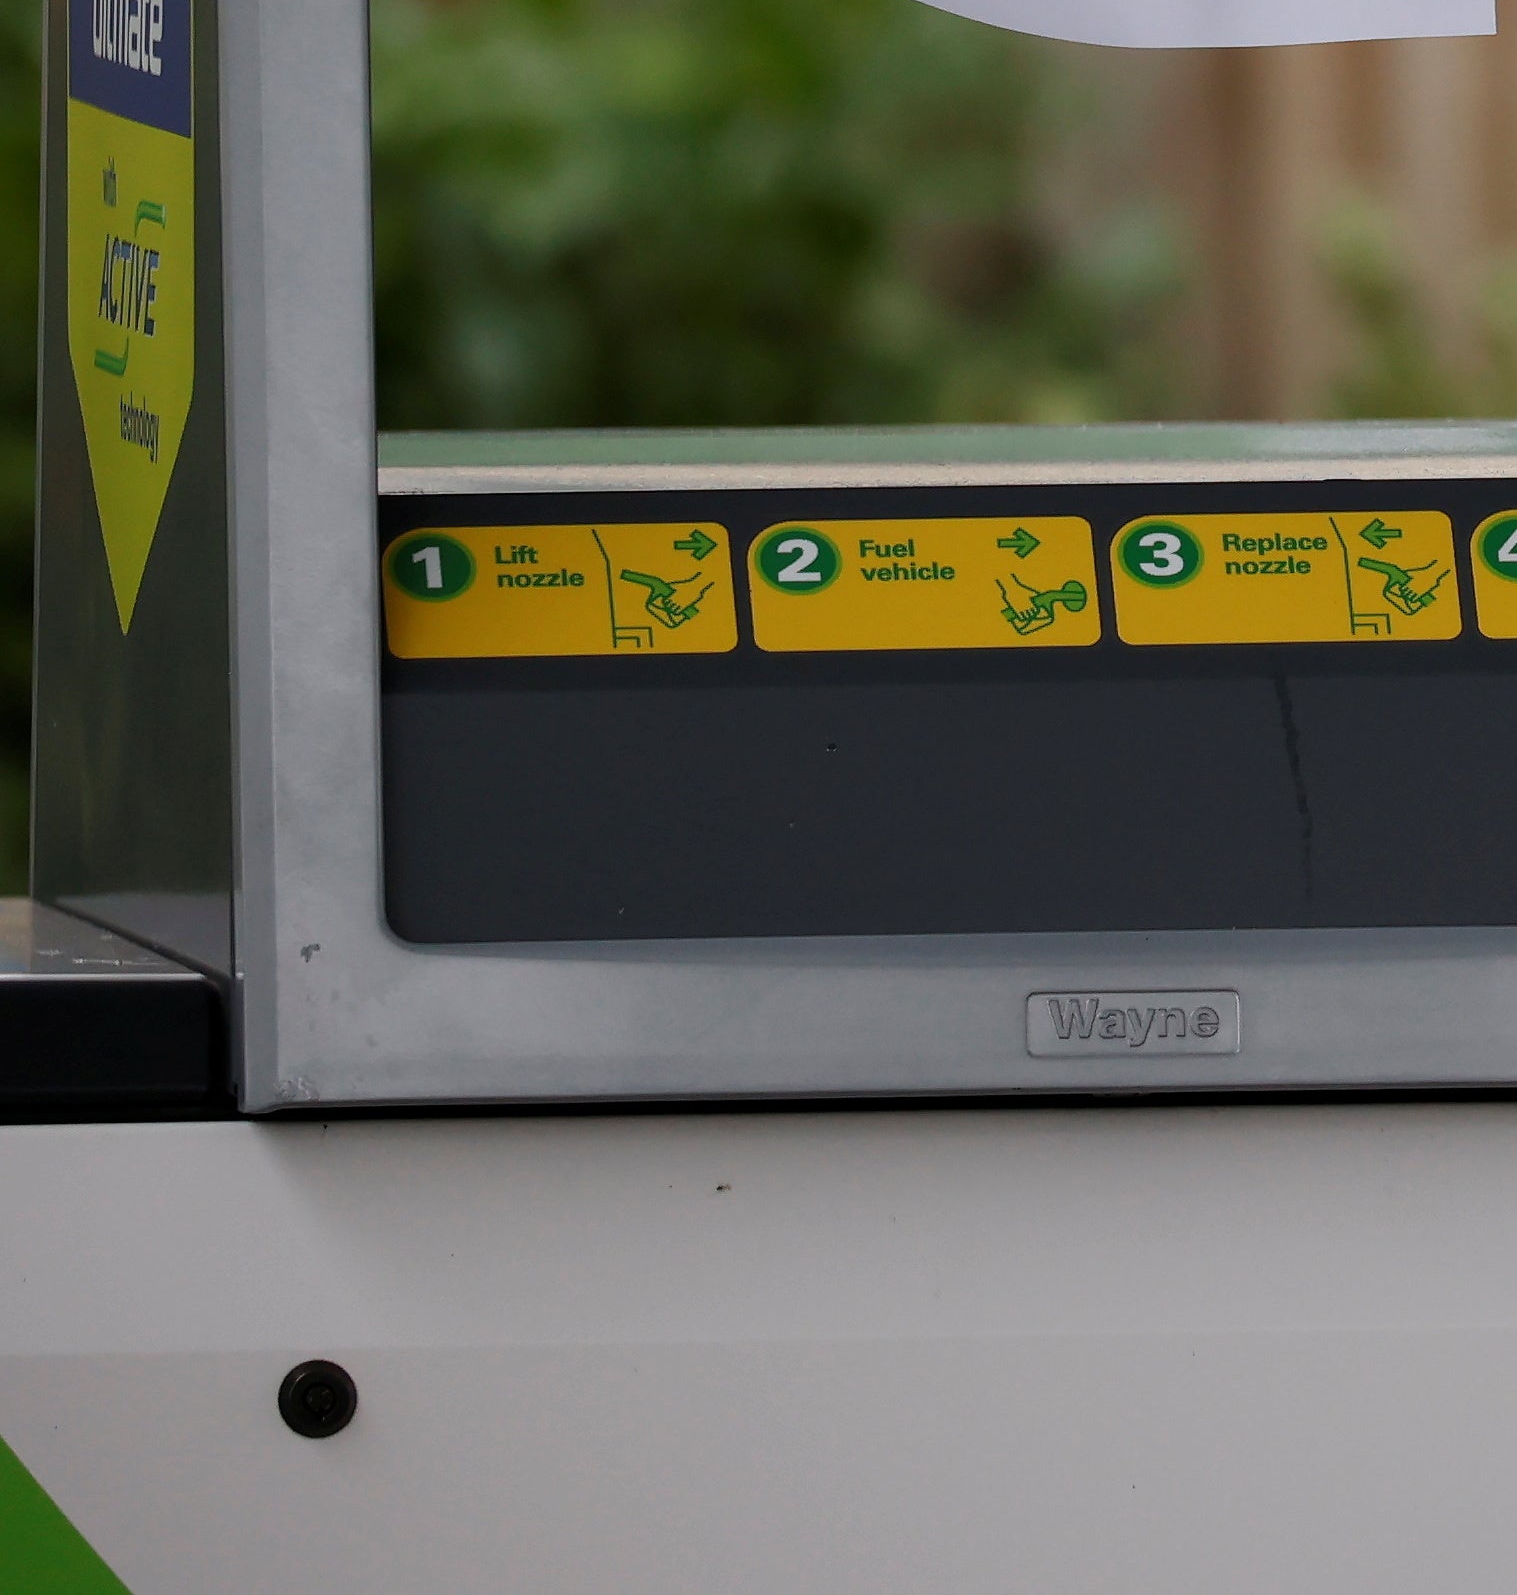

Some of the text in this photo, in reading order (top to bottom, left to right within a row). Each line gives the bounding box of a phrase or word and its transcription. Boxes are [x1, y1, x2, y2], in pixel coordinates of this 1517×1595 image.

[98, 234, 160, 337] ACTIVE
[120, 392, 159, 464] technology
[495, 546, 538, 564] Lift
[859, 539, 914, 558] Fuel
[1139, 533, 1183, 576] 3
[1223, 533, 1327, 555] Replace
[413, 547, 442, 588] 1
[777, 539, 821, 582] 2
[861, 562, 954, 581] vehicle
[1226, 556, 1311, 574] nozzle
[497, 569, 584, 588] nozzle
[1047, 998, 1220, 1048] Wayne
